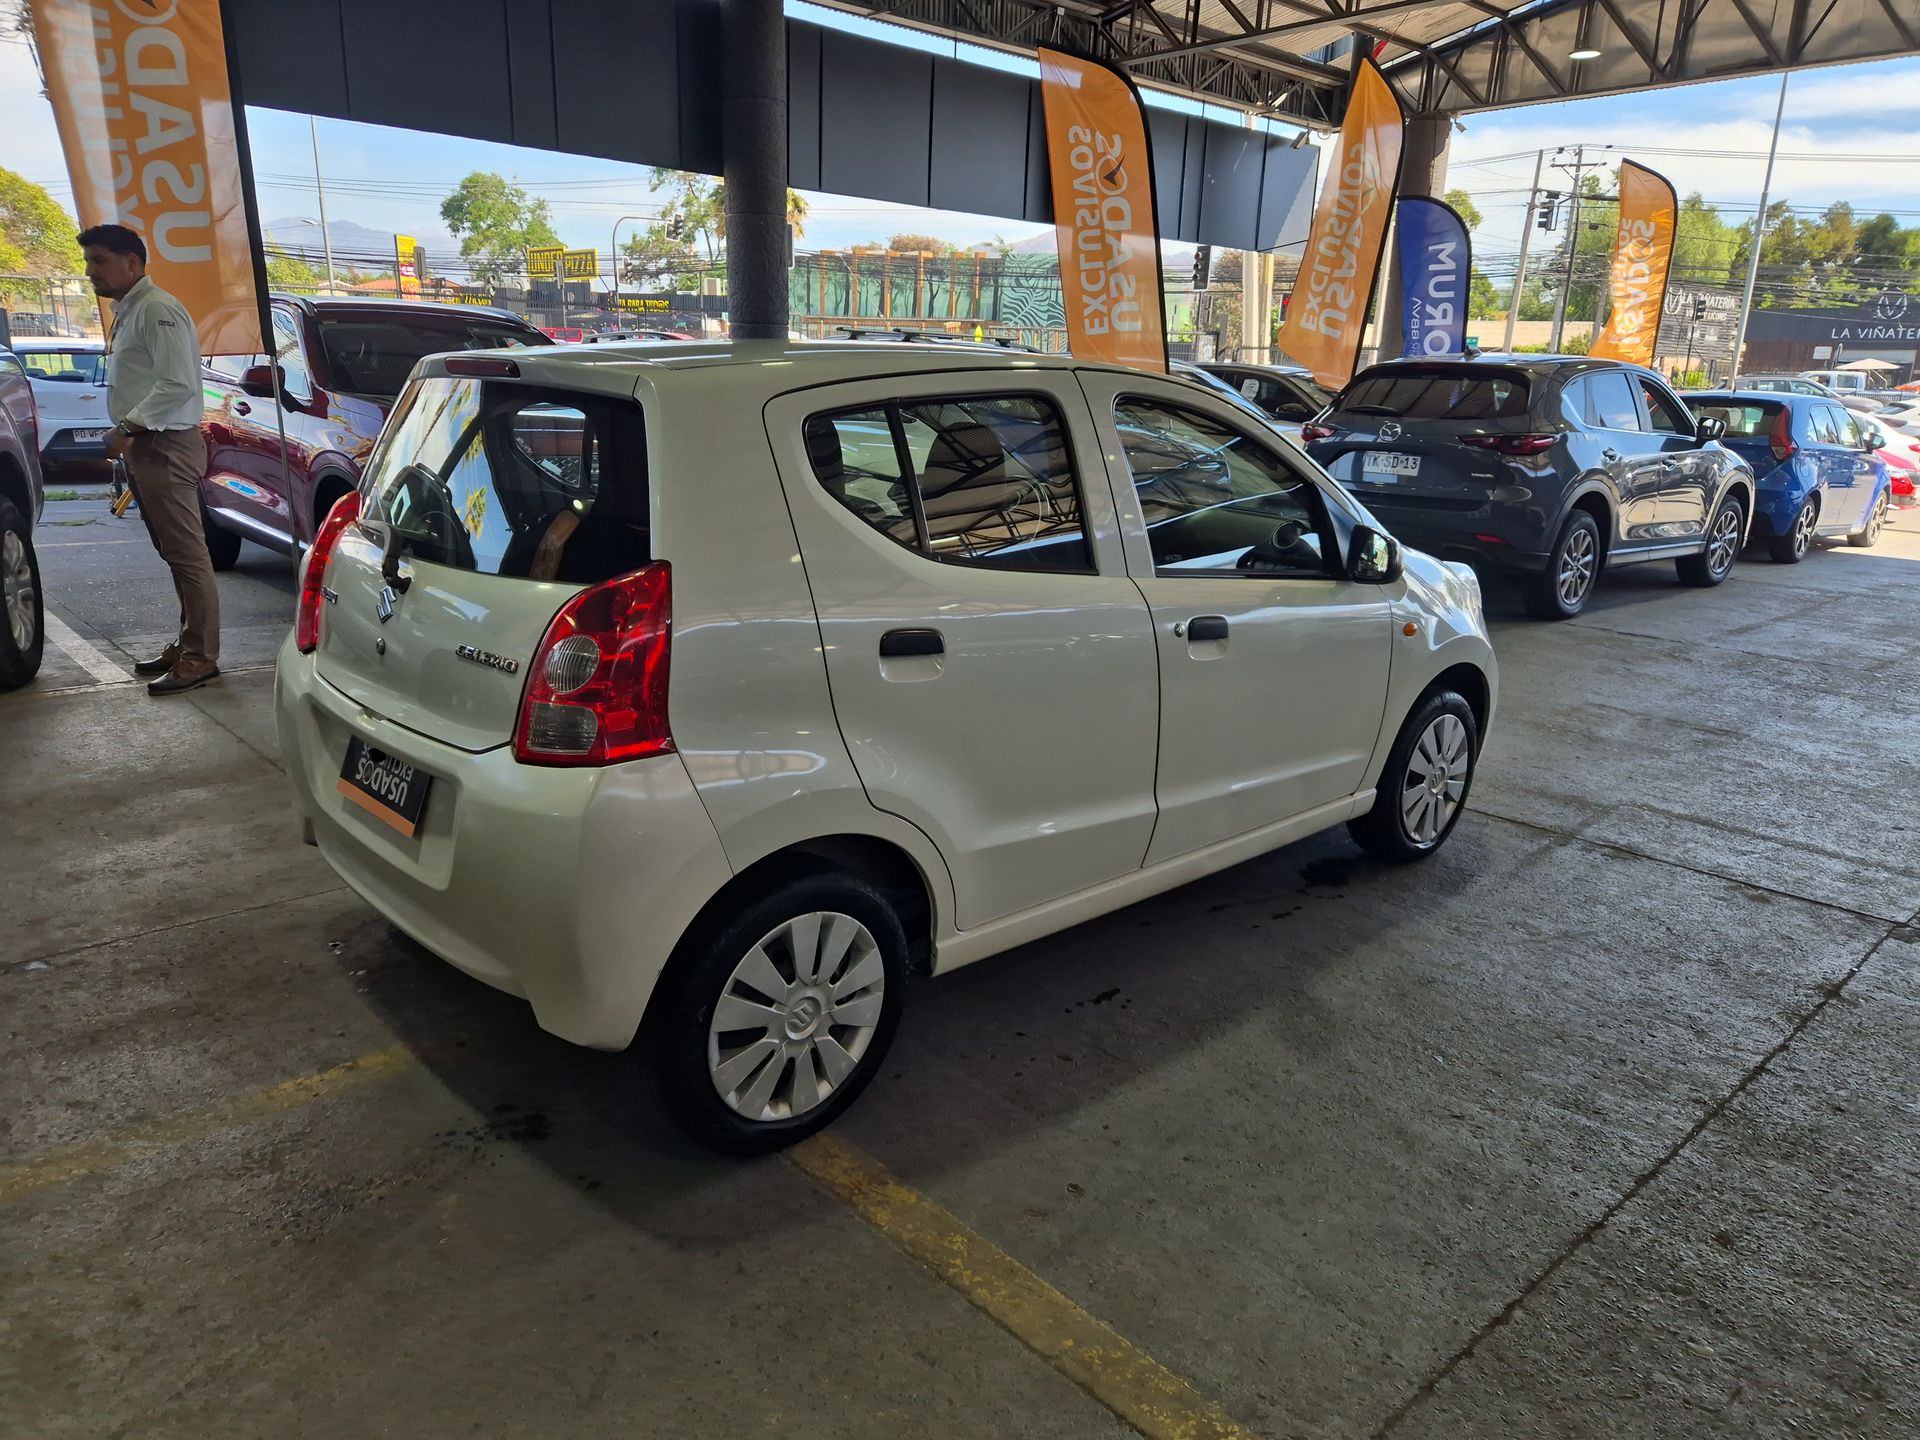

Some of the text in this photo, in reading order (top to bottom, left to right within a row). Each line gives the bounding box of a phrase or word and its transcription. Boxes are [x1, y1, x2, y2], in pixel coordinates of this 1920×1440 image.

[565, 254, 593, 274] PIZZA
[1682, 292, 1735, 309] LA ÑATERÍA
[1832, 328, 1850, 339] LA
[455, 643, 519, 674] CELERIO
[355, 758, 408, 806] USADOS
